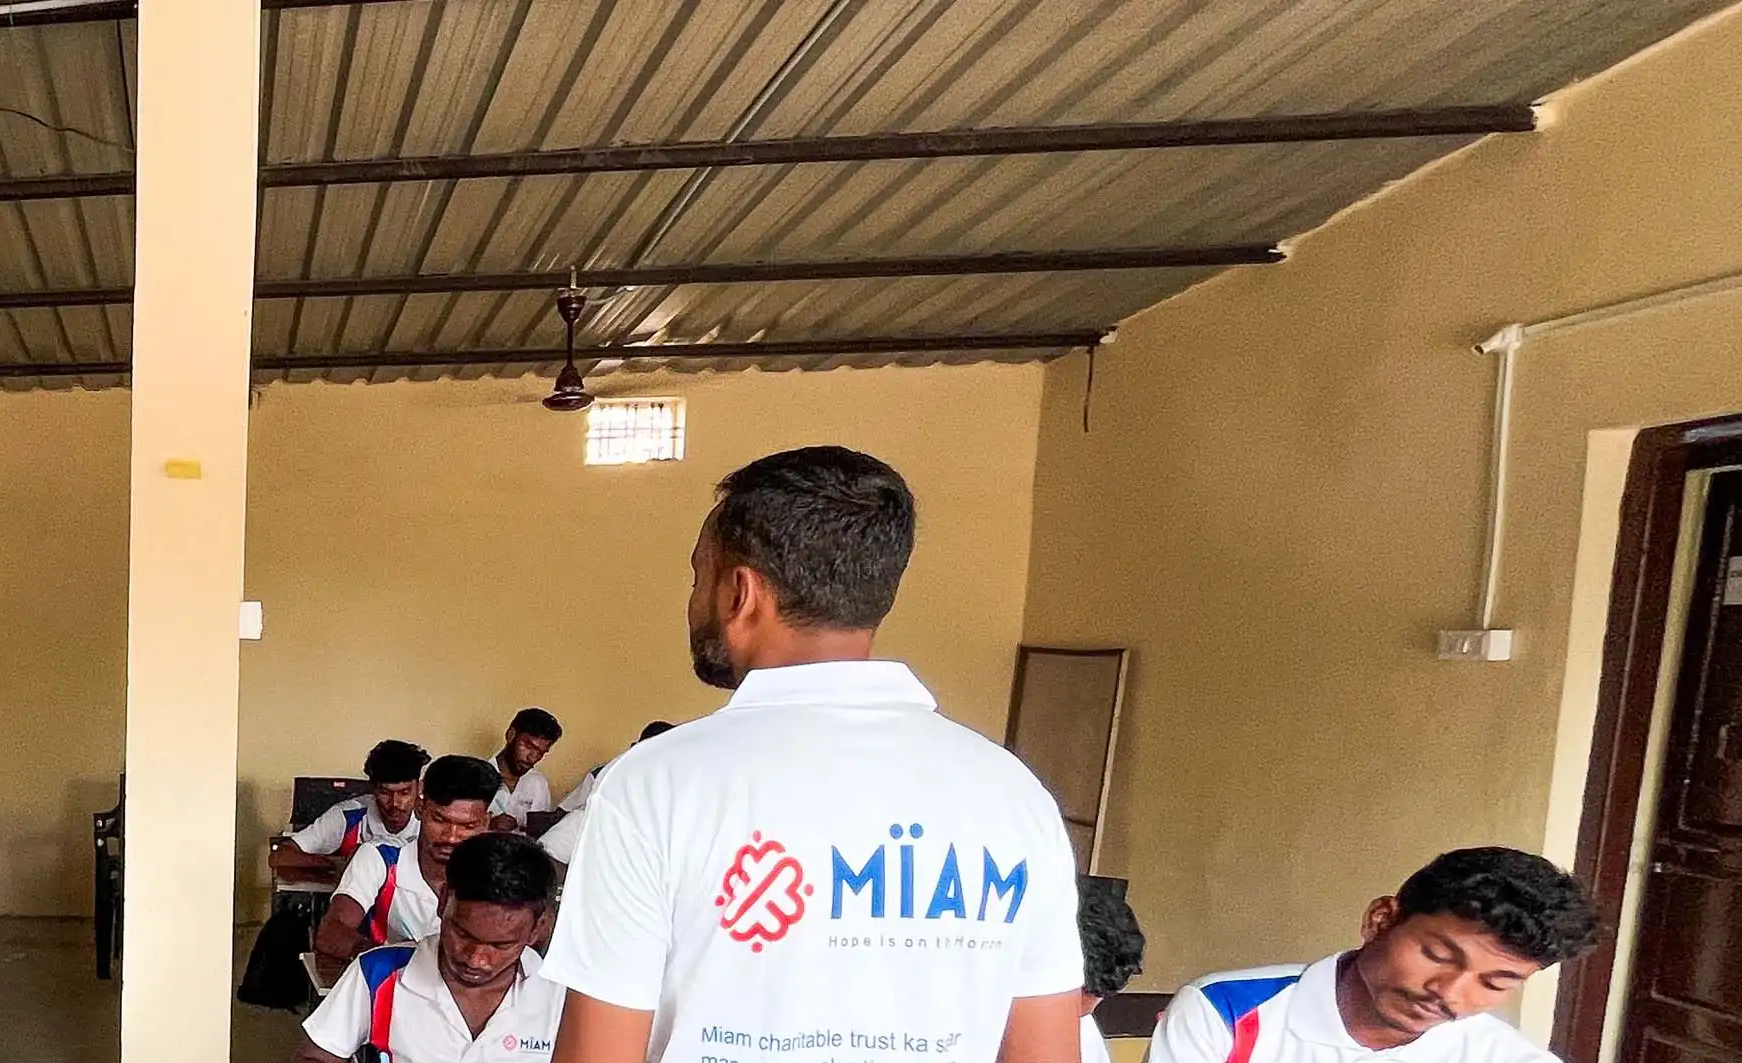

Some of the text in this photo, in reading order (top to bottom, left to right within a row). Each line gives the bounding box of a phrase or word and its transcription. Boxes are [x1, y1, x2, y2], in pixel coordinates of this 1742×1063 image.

[829, 935, 871, 950] Hope
[905, 938, 927, 949] on
[701, 1026, 752, 1048] Miam
[758, 1029, 843, 1052] charitable
[850, 1030, 897, 1050] trust
[904, 1033, 929, 1053] ka
